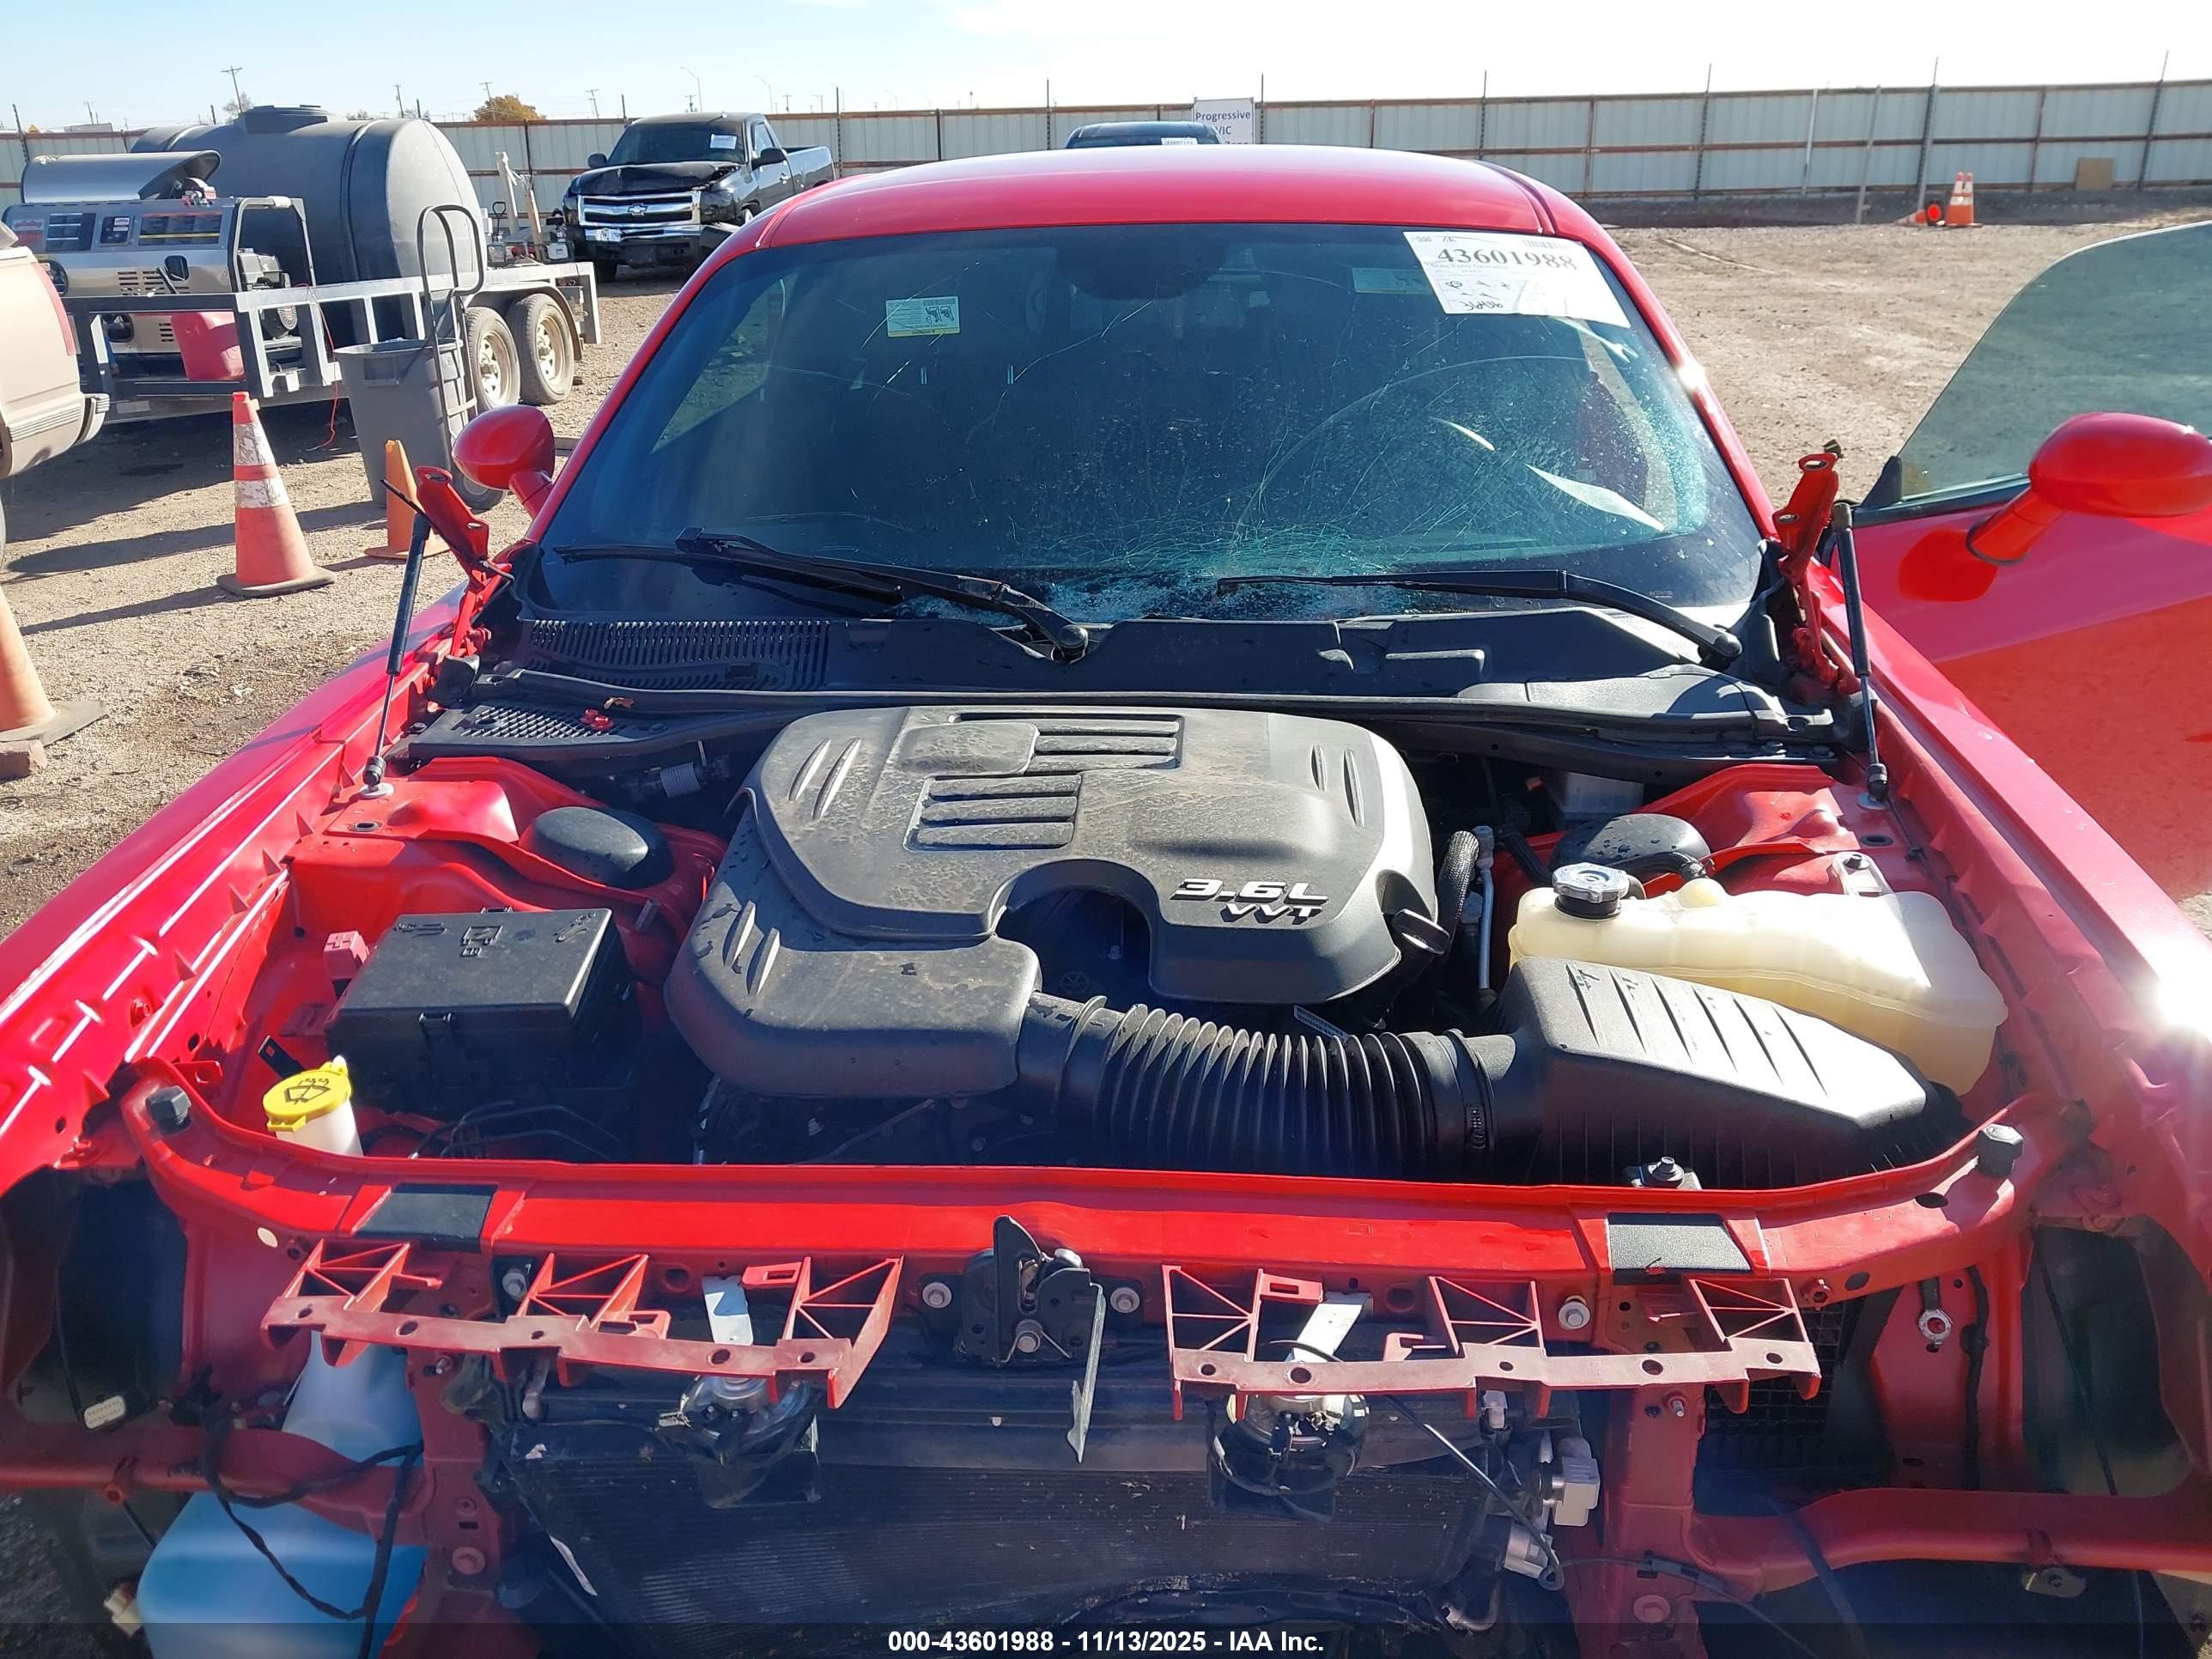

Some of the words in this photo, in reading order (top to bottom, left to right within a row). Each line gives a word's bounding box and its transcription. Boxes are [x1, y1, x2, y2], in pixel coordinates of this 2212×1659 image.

[1195, 110, 1251, 122] Progressive
[1437, 247, 1578, 270] 43601988
[1170, 878, 1329, 903] 3.6L
[1223, 902, 1323, 922] VVT
